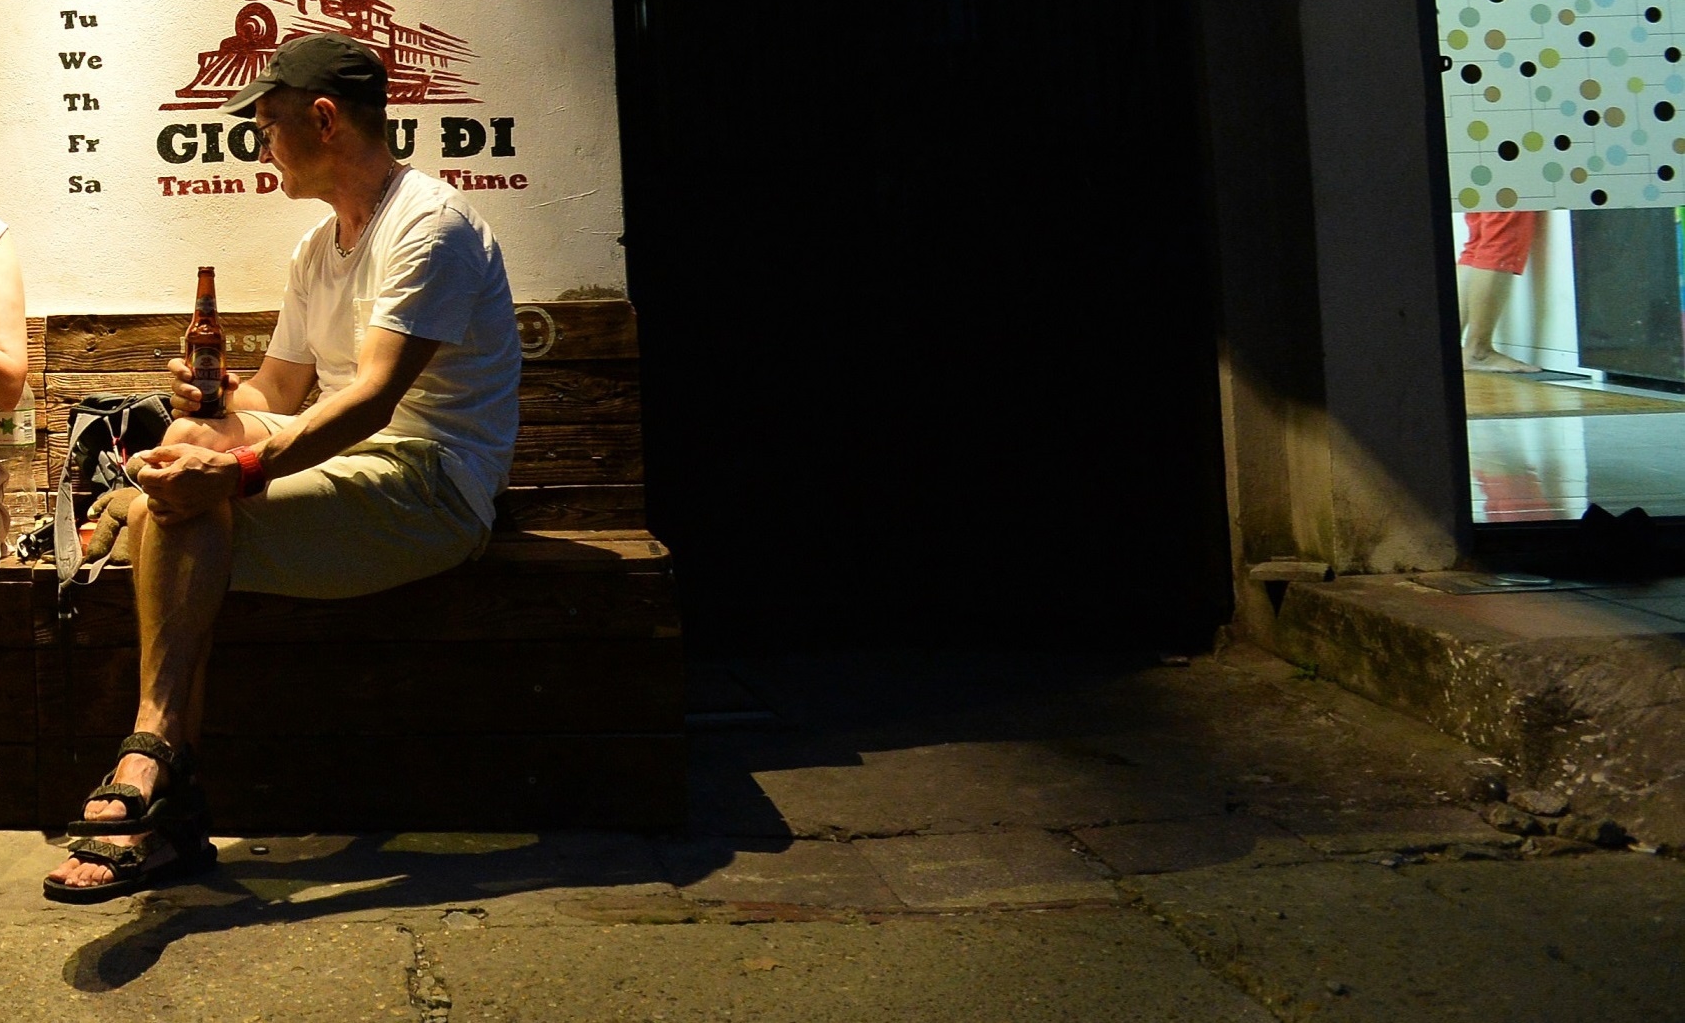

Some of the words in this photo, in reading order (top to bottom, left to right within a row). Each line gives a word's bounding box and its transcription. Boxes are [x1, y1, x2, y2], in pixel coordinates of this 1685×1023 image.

[60, 10, 98, 29] Tu
[58, 51, 103, 70] We
[63, 93, 100, 112] Th
[68, 134, 100, 153] Fr
[441, 116, 516, 158] ĐI
[68, 175, 101, 194] Sa
[157, 174, 246, 197] Train
[439, 168, 529, 191] Time
